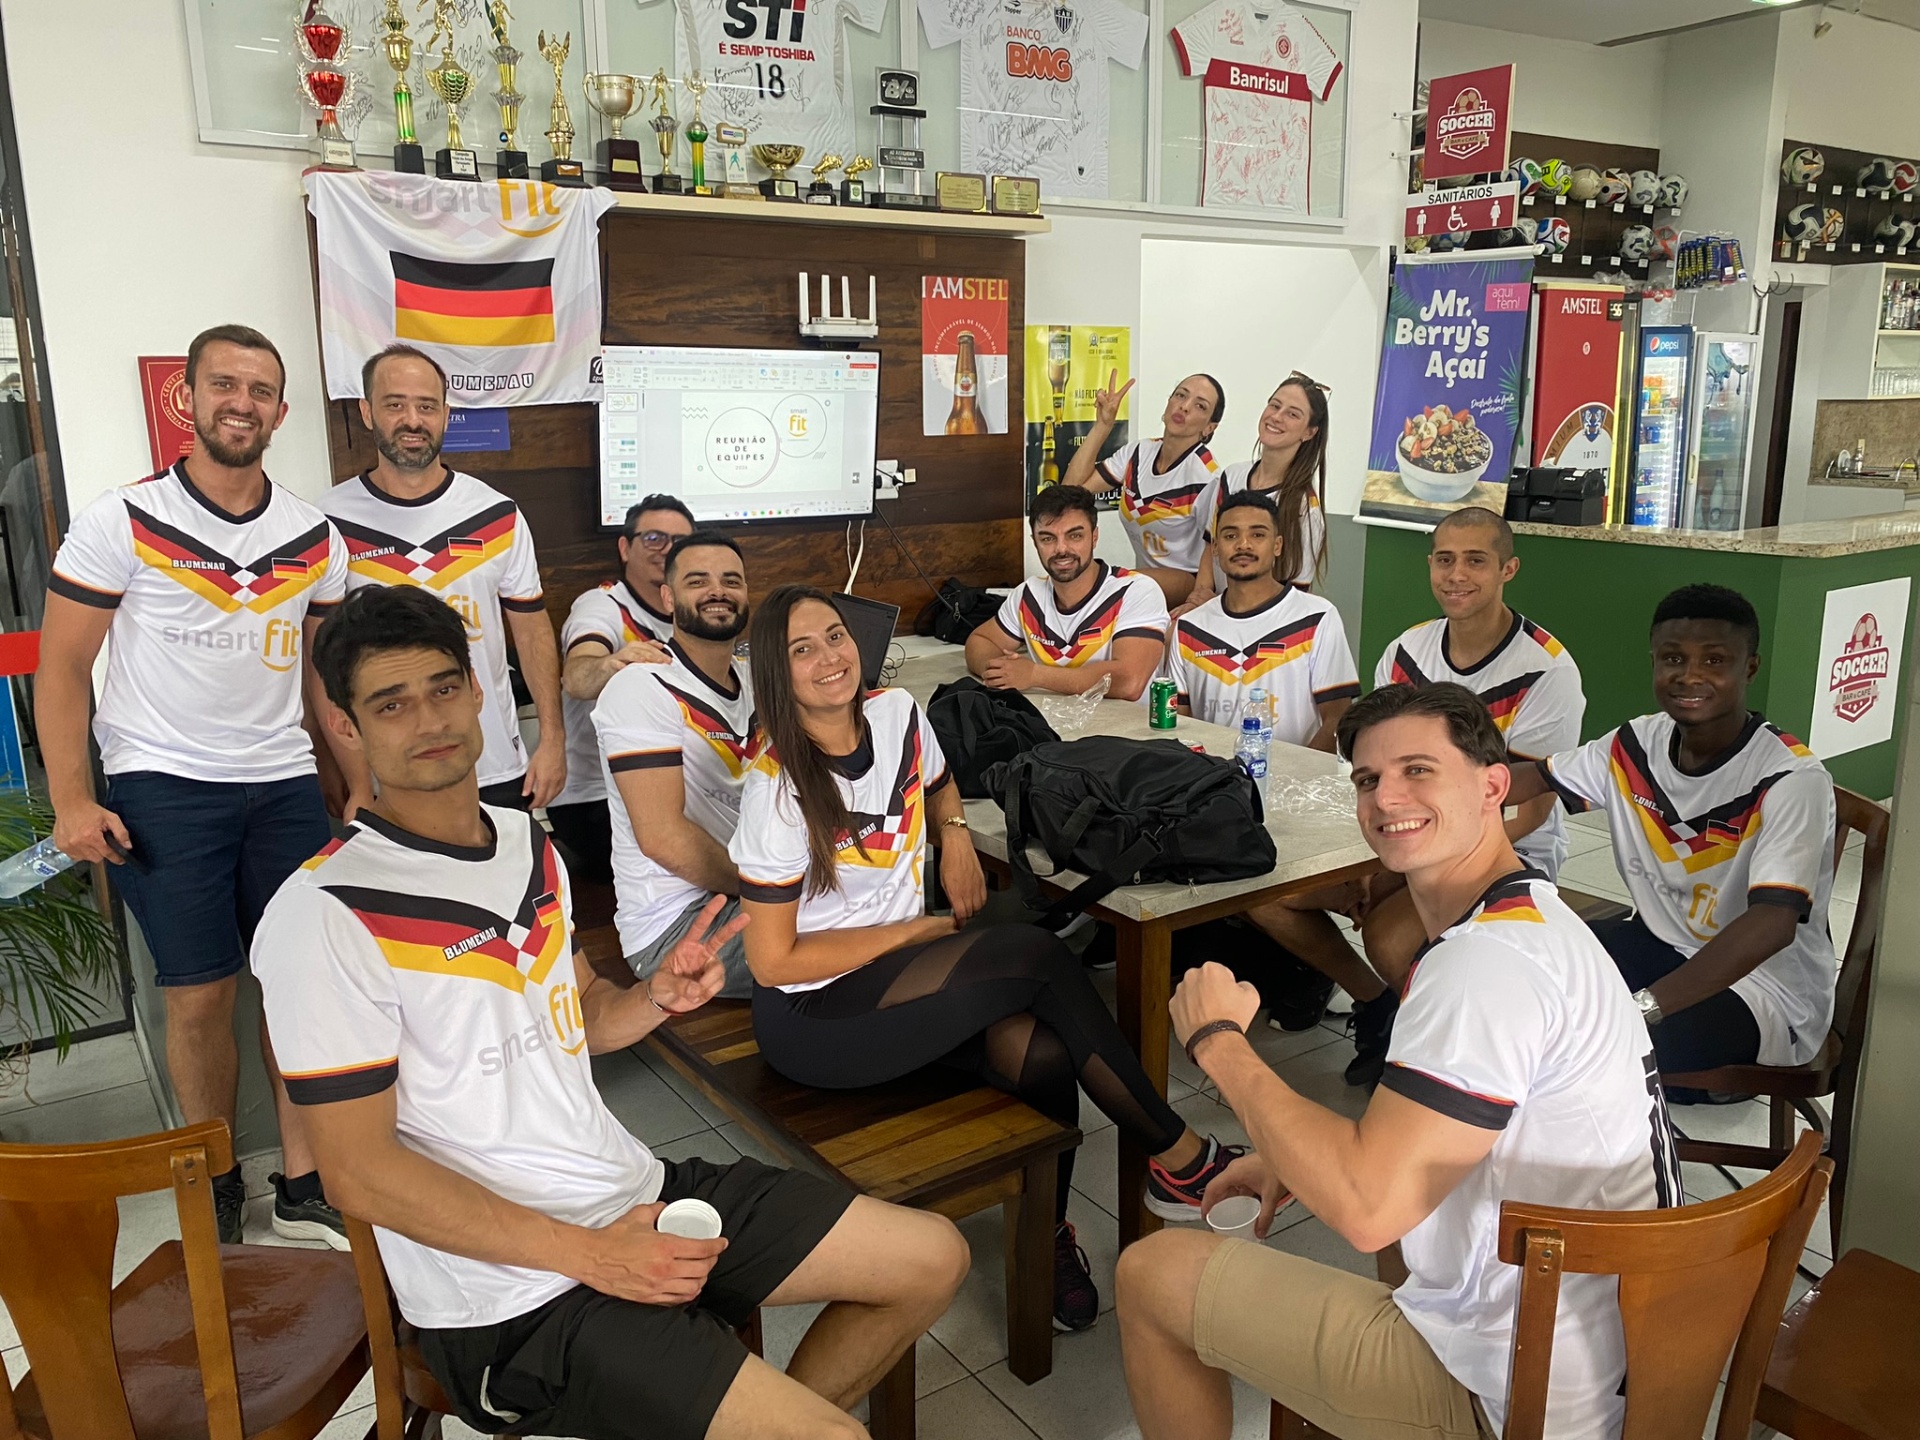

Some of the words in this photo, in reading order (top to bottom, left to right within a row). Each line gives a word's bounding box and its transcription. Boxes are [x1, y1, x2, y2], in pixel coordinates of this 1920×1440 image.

[1007, 26, 1041, 42] BANCO
[719, 41, 727, 54] É
[730, 44, 764, 57] SEMP
[765, 47, 815, 61] TOSHIBA
[1006, 41, 1072, 82] BMG
[755, 63, 785, 99] 18
[1230, 66, 1289, 94] Banrisul
[1439, 112, 1494, 135] SOCCER
[1428, 187, 1493, 205] SANITÁRIOS
[932, 277, 1008, 301] AMSTEL
[1492, 287, 1513, 301] aqui
[1420, 289, 1471, 322] Mr.
[1496, 297, 1520, 309] tem!
[1561, 298, 1602, 315] AMSTEL
[1394, 318, 1490, 353] Berry's
[1660, 340, 1680, 352] pepsi
[1425, 350, 1488, 388] Açaí
[446, 373, 534, 391] UMENAU
[789, 415, 807, 431] fit
[715, 435, 766, 444] REUNIÃO
[1583, 450, 1598, 459] 1870
[350, 546, 396, 562] BLUMENAU
[172, 559, 226, 571] BLUMENAU
[162, 626, 259, 652] smart
[263, 617, 300, 657] fit
[1832, 651, 1887, 687] SOCCER
[1842, 693, 1853, 702] BAR
[835, 822, 878, 851] BLUENAU
[443, 926, 498, 961] BLUMENAU
[477, 1012, 553, 1077] smart
